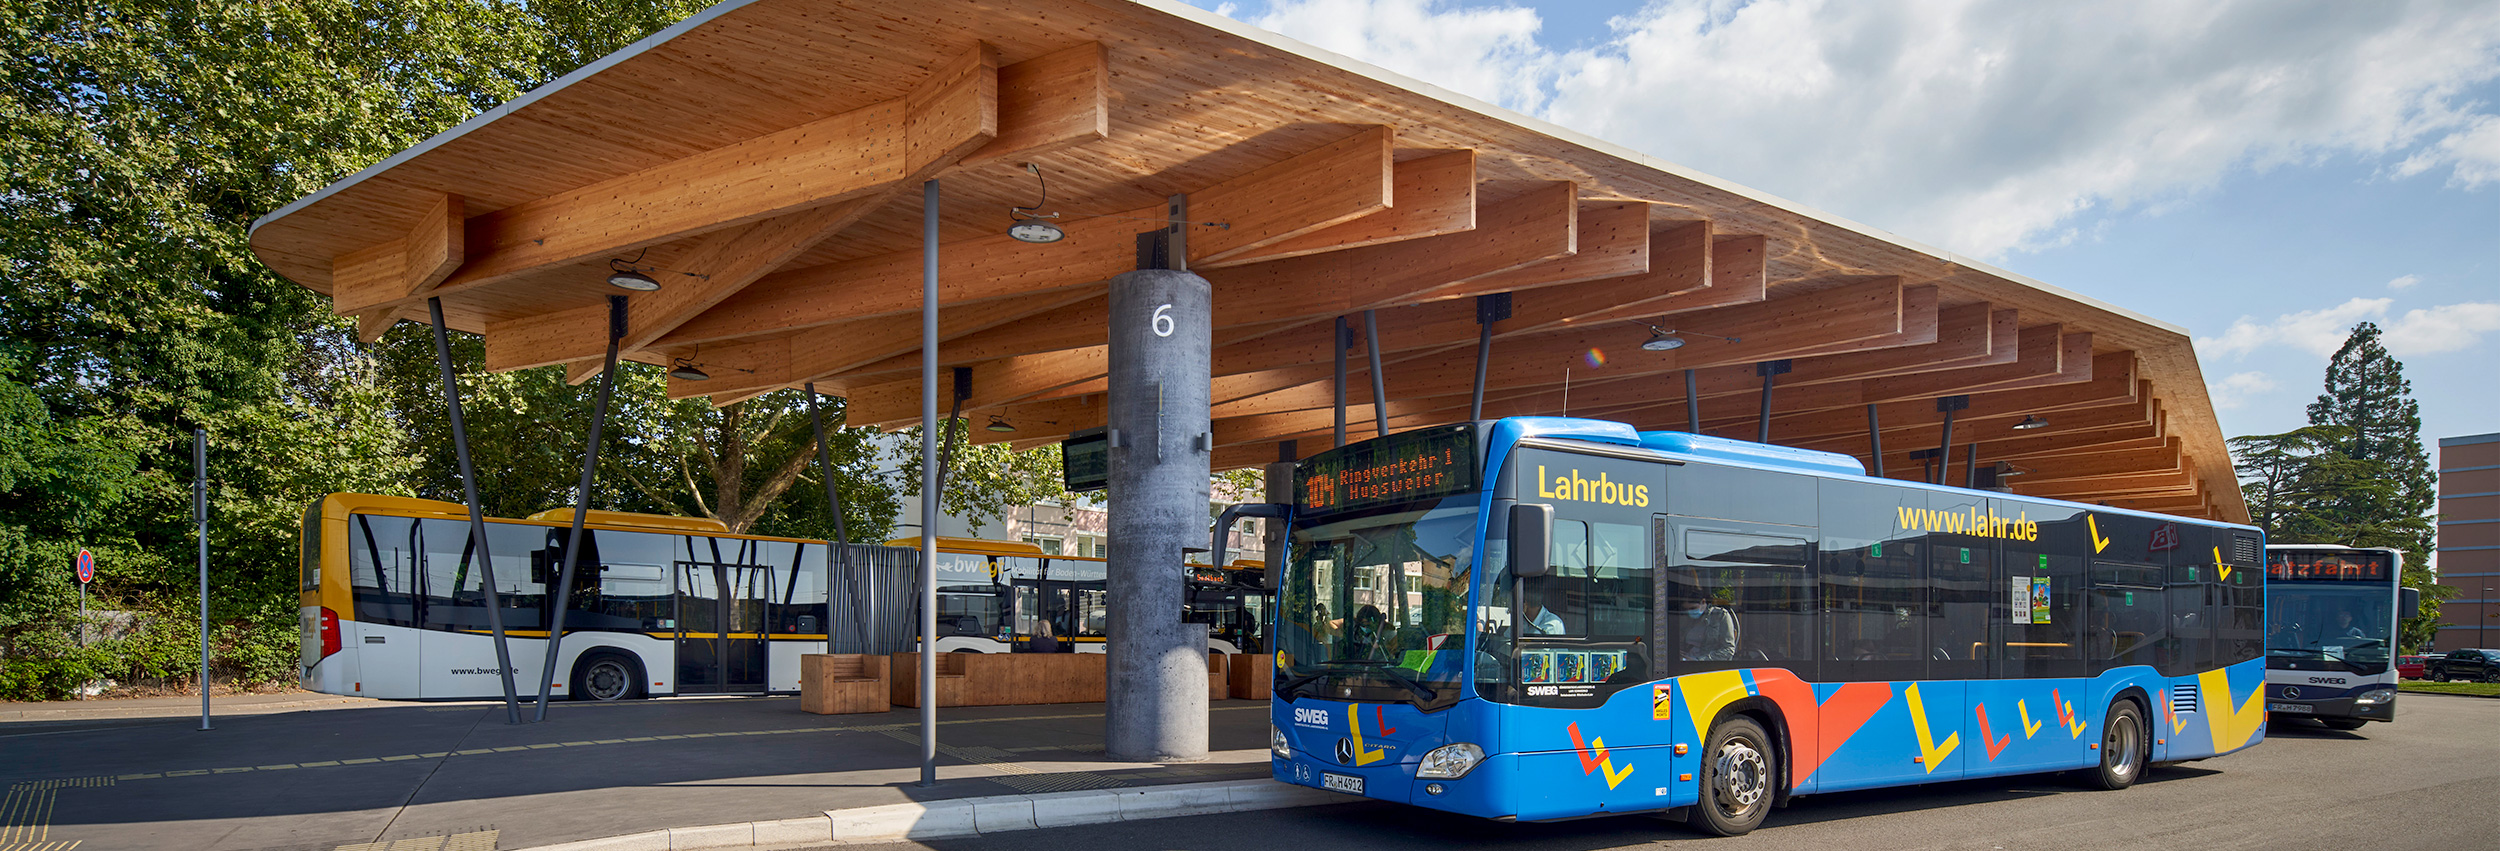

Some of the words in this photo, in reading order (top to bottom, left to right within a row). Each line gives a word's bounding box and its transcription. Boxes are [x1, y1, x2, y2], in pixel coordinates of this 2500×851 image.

[1152, 304, 1175, 337] 6
[1340, 453, 1438, 486] Ringverkehr
[1445, 448, 1453, 465] 1
[1306, 473, 1334, 508] 104
[1350, 472, 1444, 500] Hugsweier
[1538, 465, 1649, 508] Lahrbus
[1898, 506, 2038, 542] www.lahr.de
[954, 556, 1005, 578] bwegt
[451, 667, 519, 676] www.bwege
[2309, 677, 2346, 685] SWEG
[1527, 685, 1559, 696] SWEG
[1294, 707, 1329, 725] SWEG
[1324, 774, 1334, 787] FR
